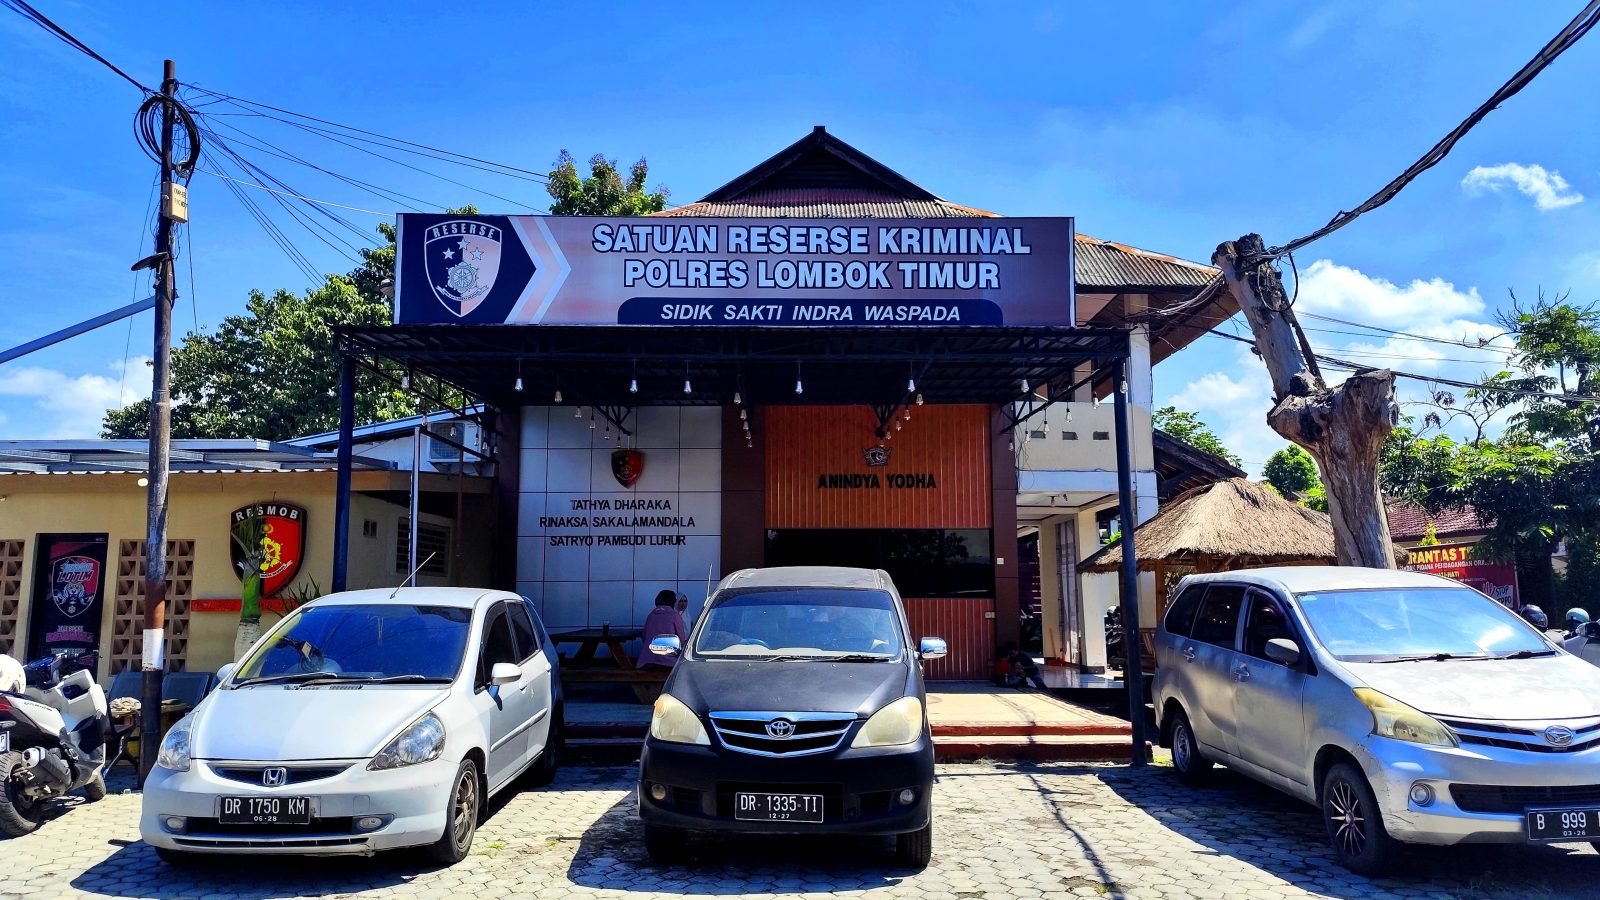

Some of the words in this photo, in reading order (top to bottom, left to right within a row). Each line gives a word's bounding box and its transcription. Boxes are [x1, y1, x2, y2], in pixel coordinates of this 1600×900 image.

[432, 223, 496, 239] RESERSE
[592, 224, 718, 253] SATUAN
[727, 226, 869, 254] RESERSE
[877, 227, 1032, 255] KRIMINAL
[624, 259, 749, 288] POLRES
[756, 260, 893, 289] LOMBOK
[898, 262, 1001, 290] TIMUR
[661, 304, 714, 320] SIDIK
[723, 305, 782, 321] SAKTI
[792, 305, 853, 321] INDRA
[864, 306, 961, 321] WASPADA
[818, 474, 880, 489] ANINDYA
[886, 474, 937, 489] YODHA
[570, 499, 611, 511] TATHYA
[614, 499, 671, 511] DHARAKA
[539, 516, 589, 528] RINAKSA
[592, 516, 696, 528] SAKALAMANDALA
[549, 535, 594, 547] SATRYO
[597, 535, 646, 547] PAMBUDI
[650, 535, 686, 547] LUHUR
[1407, 547, 1458, 565] RANTAS
[224, 798, 242, 814] DR
[249, 799, 280, 814] 1750
[288, 799, 305, 815] KM
[740, 795, 756, 811] DR
[767, 796, 797, 811] 1335
[803, 796, 817, 812] TI
[1536, 813, 1546, 830] B
[1561, 812, 1587, 829] 999
